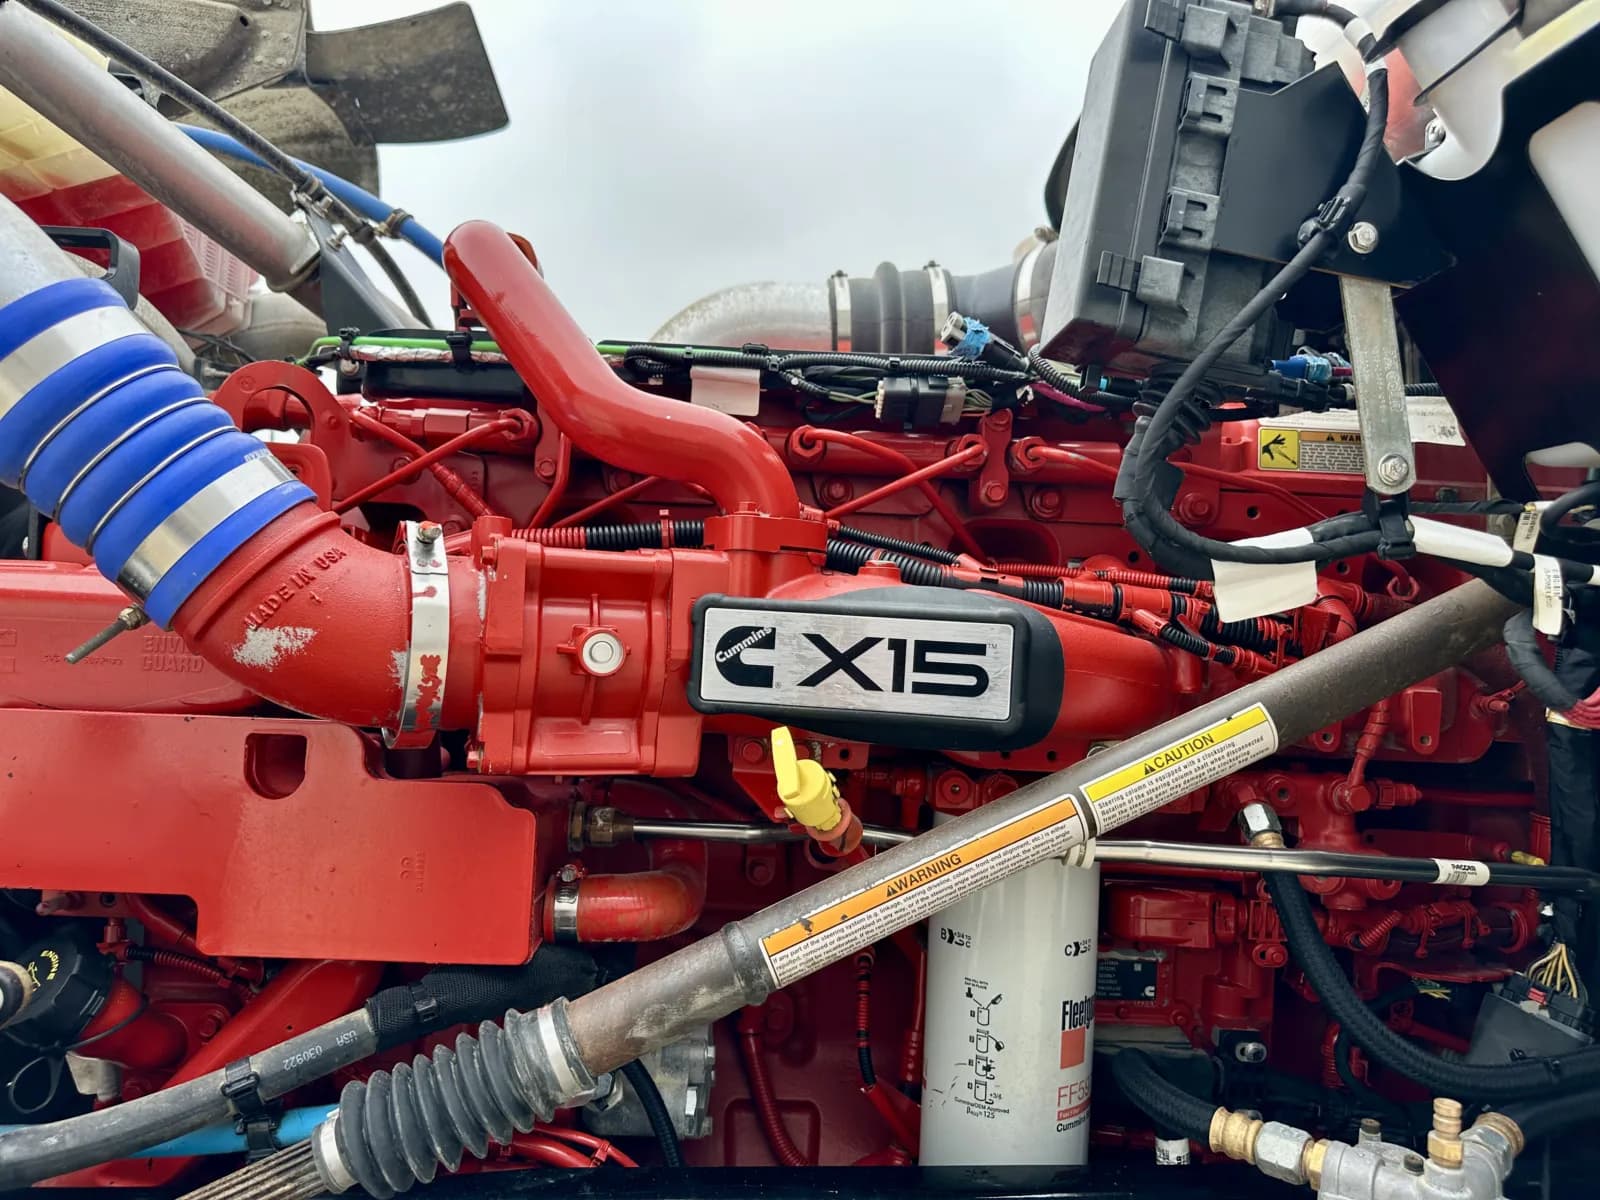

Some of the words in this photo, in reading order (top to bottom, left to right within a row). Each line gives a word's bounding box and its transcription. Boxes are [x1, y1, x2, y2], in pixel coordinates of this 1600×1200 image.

[243, 582, 295, 632] MADE
[290, 566, 317, 590] IN
[313, 547, 347, 571] USA
[716, 625, 772, 663] Cummins
[142, 655, 204, 673] GUARD
[797, 632, 990, 699] X15
[1152, 732, 1214, 769] CAUTION
[1097, 793, 1124, 809] Steering
[1123, 782, 1146, 796] column
[1154, 765, 1182, 783] equipped
[1182, 759, 1195, 769] with
[1201, 740, 1235, 761] clockspring
[1100, 800, 1126, 816] Rotation
[1134, 792, 1144, 800] the
[1145, 780, 1170, 796] steering
[1170, 769, 1192, 783] column
[1193, 761, 1209, 772] shaft
[1209, 754, 1225, 764] when
[1225, 735, 1264, 757] disconnected
[1117, 807, 1127, 815] the
[1128, 795, 1153, 811] steering
[1206, 765, 1215, 773] the
[882, 912, 893, 921] any
[919, 894, 929, 902] the
[929, 883, 953, 898] steering
[953, 876, 970, 887] angle
[1021, 847, 1031, 855] the
[1031, 836, 1054, 851] steering
[1054, 829, 1070, 840] angle
[892, 852, 962, 892] WARNING
[777, 953, 789, 962] any
[789, 946, 803, 956] part
[809, 937, 820, 946] the
[820, 926, 845, 942] steering
[844, 916, 866, 930] system
[902, 888, 926, 903] steering
[1049, 822, 1066, 834] either
[940, 927, 947, 941] B
[1064, 944, 1073, 957] C
[40, 950, 60, 981] ENGINE
[1061, 994, 1093, 1030] Fleetg
[282, 1044, 323, 1071] 030922
[335, 1029, 358, 1048] USA
